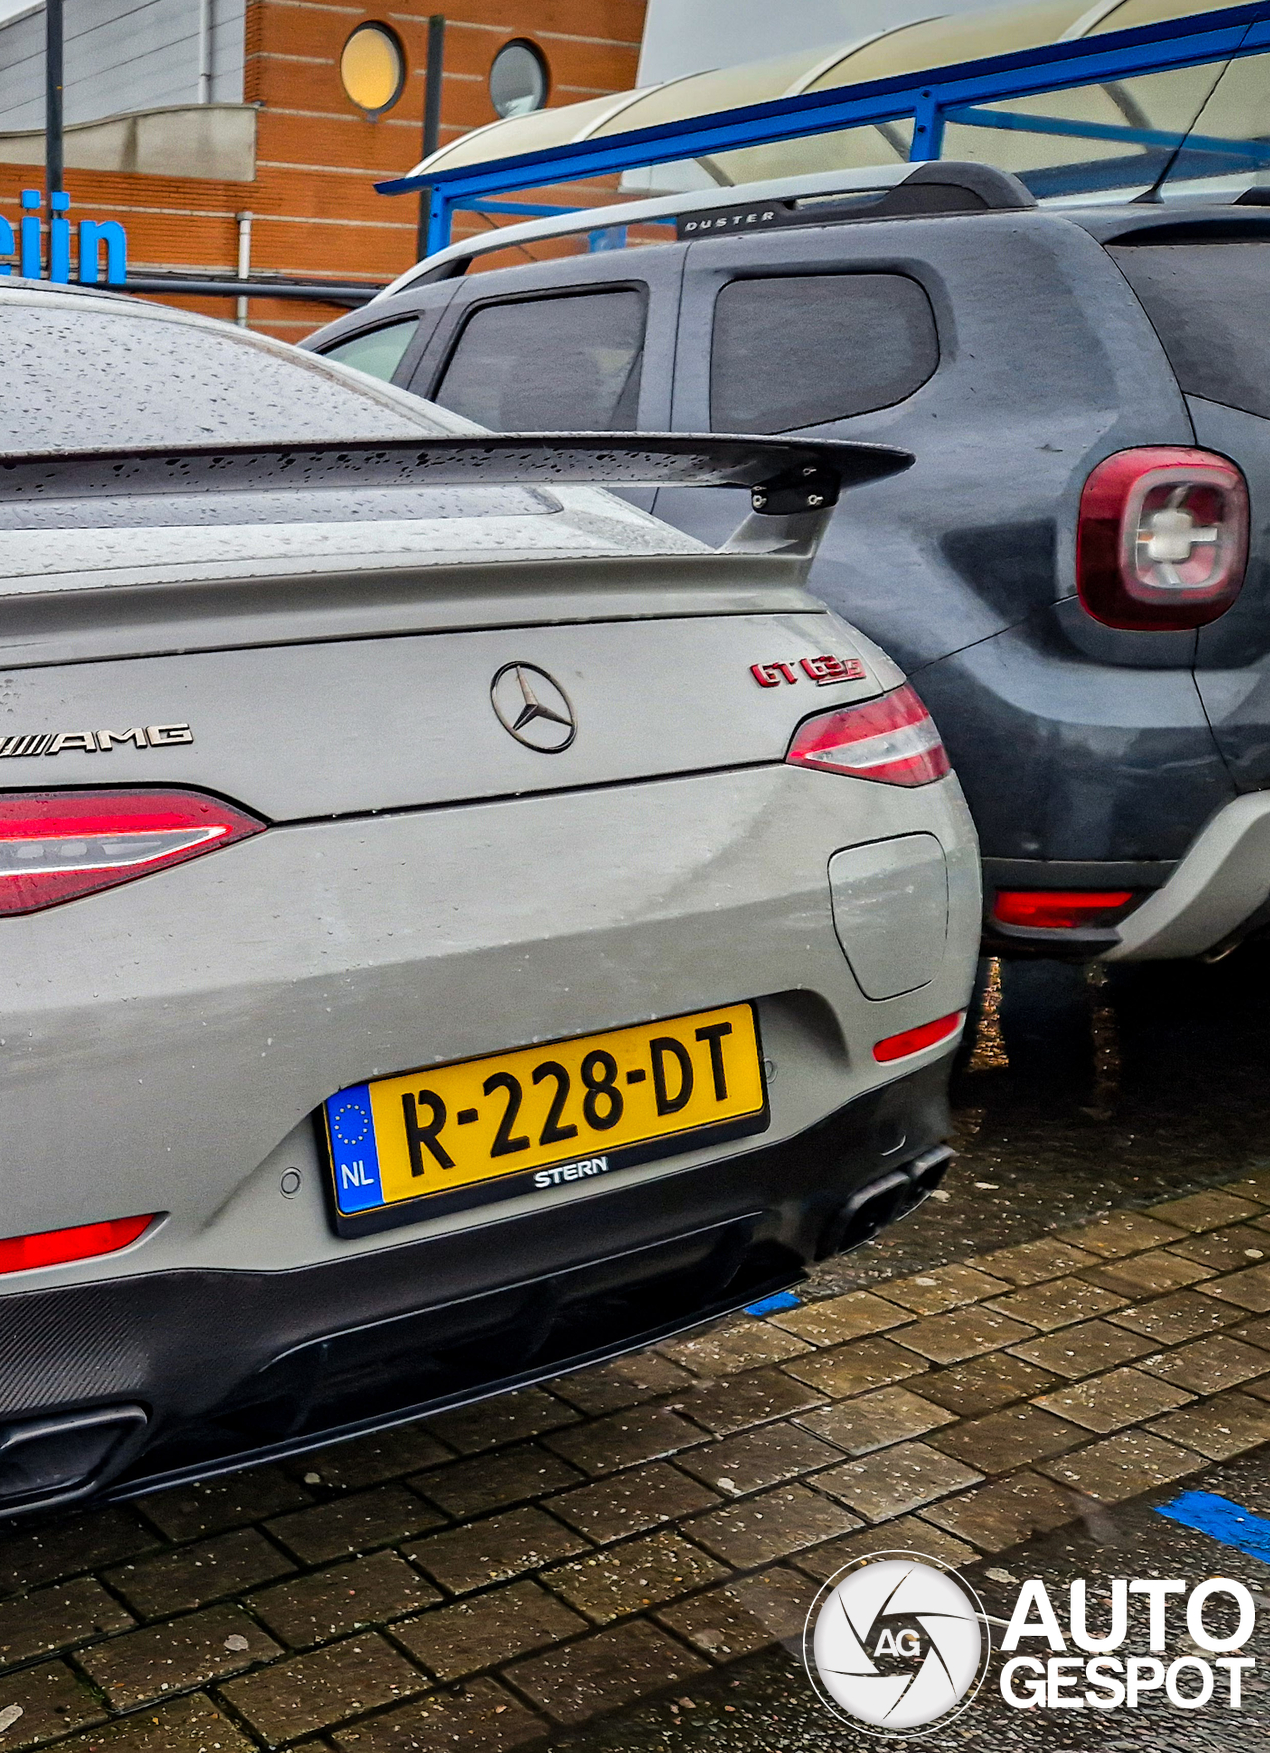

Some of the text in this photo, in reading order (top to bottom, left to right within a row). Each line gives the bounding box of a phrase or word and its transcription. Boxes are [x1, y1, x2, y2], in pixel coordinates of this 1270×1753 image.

[684, 211, 775, 232] DUSTER
[750, 662, 799, 687] GT
[44, 723, 194, 755] AMG
[401, 1021, 733, 1178] R-228-DT
[341, 1163, 375, 1190] NL
[533, 1156, 610, 1189] STERN
